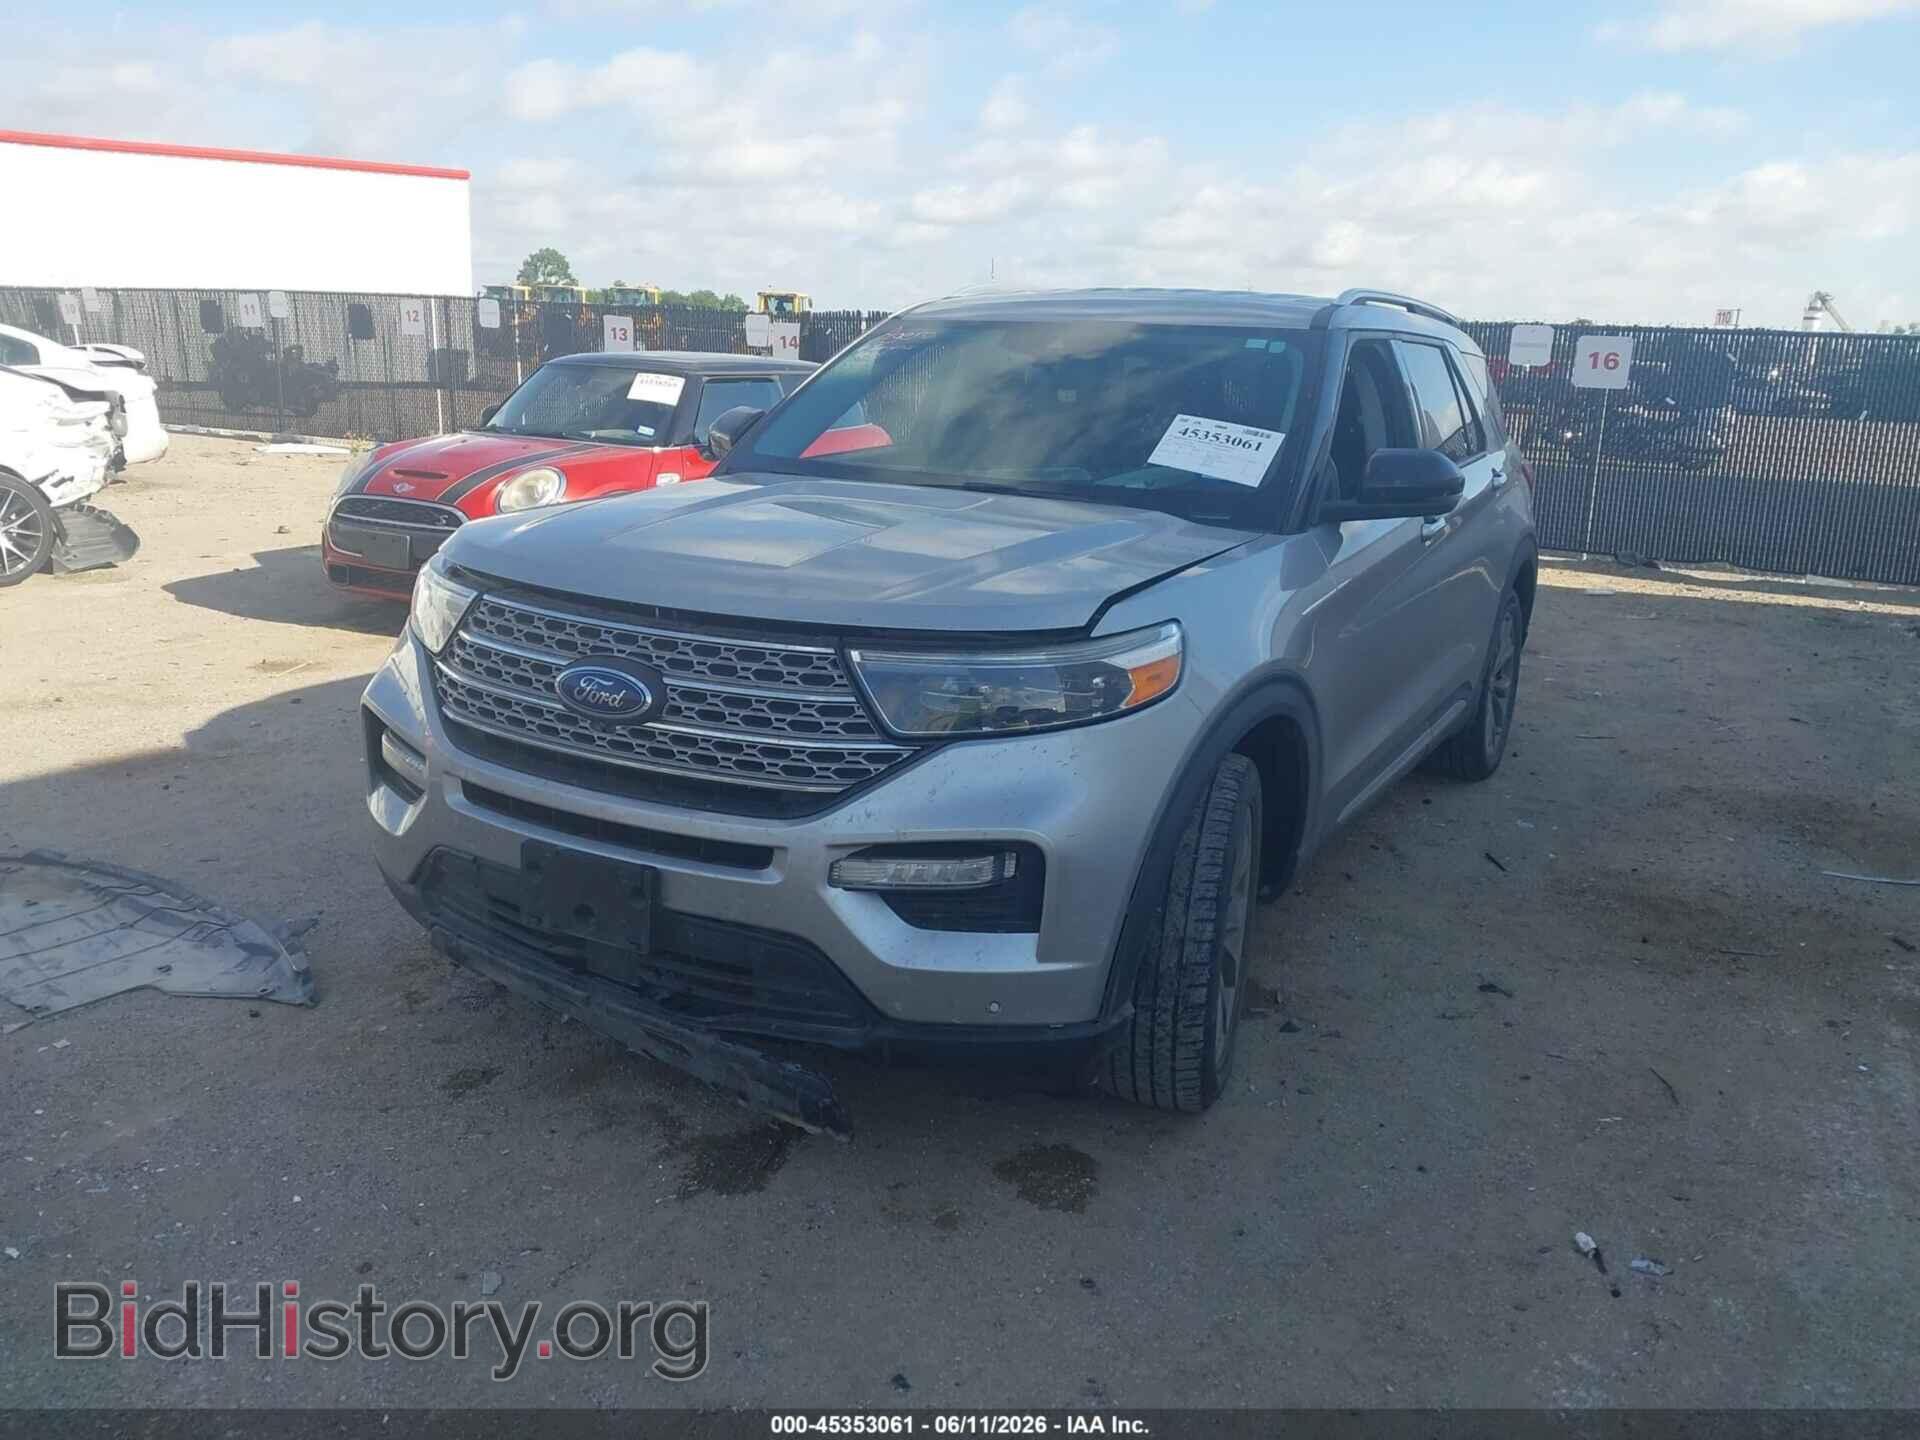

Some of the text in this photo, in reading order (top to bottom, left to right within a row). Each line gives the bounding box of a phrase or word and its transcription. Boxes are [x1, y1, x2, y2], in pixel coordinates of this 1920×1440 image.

[243, 304, 256, 316] 11
[406, 310, 419, 322] 12
[610, 327, 628, 341] 13
[779, 335, 800, 349] 14
[1588, 351, 1620, 370] 16
[1178, 427, 1263, 451] 45353061
[574, 676, 627, 708] Ford
